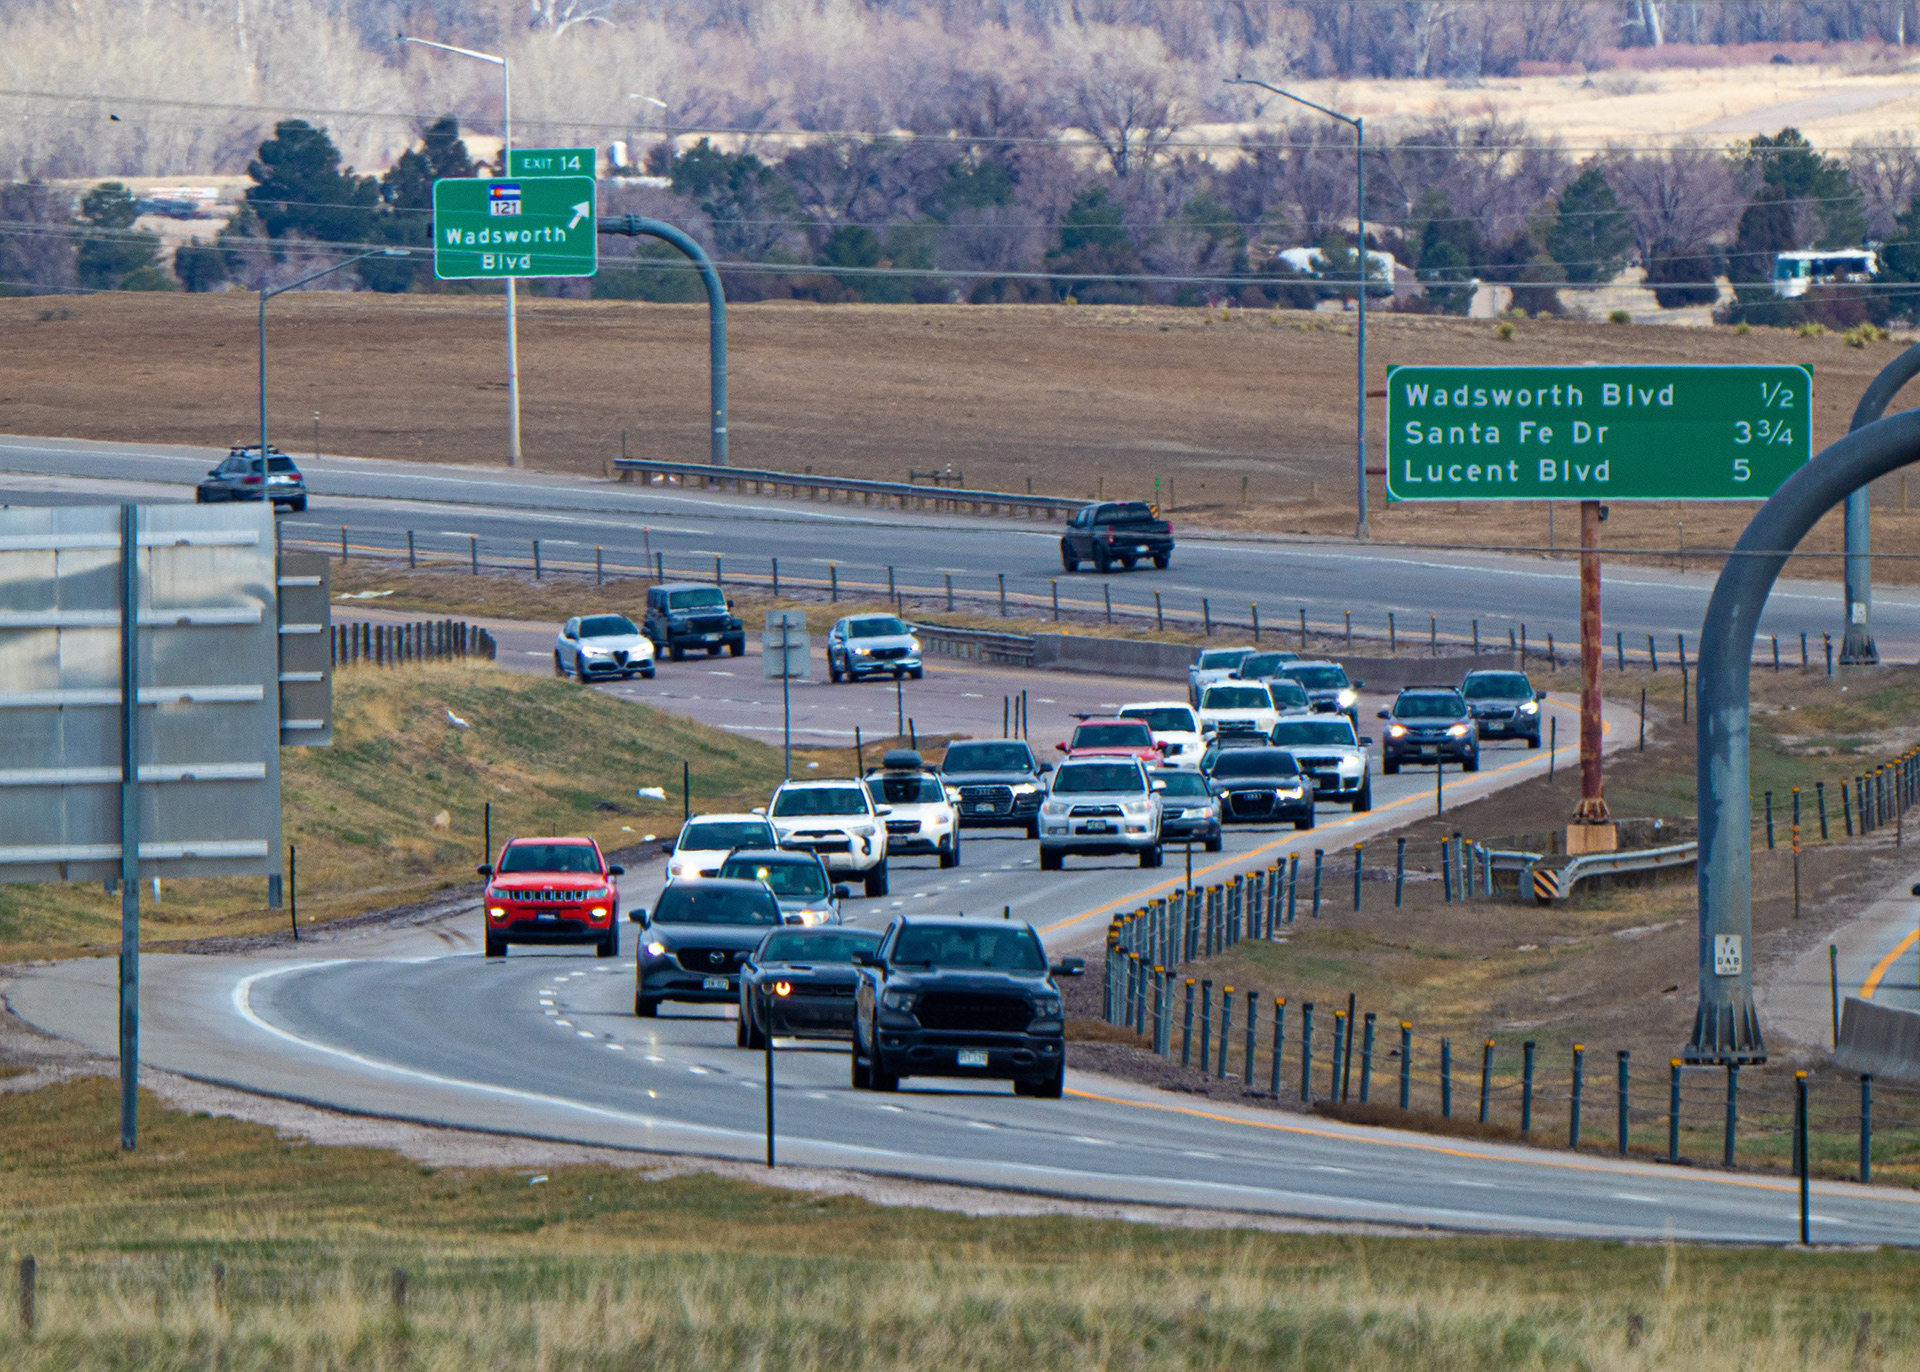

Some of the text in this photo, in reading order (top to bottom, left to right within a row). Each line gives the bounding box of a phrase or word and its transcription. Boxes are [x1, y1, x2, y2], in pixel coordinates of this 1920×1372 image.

[524, 156, 581, 170] EXIT 14
[494, 202, 517, 214] 121
[446, 228, 566, 245] Wadsworth
[483, 253, 531, 269] Blvd
[1406, 384, 1583, 406] Wadsworth
[1603, 384, 1674, 406] Blvd
[1406, 421, 1500, 444] Santa
[1519, 421, 1553, 443] Fe
[1573, 421, 1609, 443] Dr
[1405, 459, 1752, 482] Lucent Blvd 5
